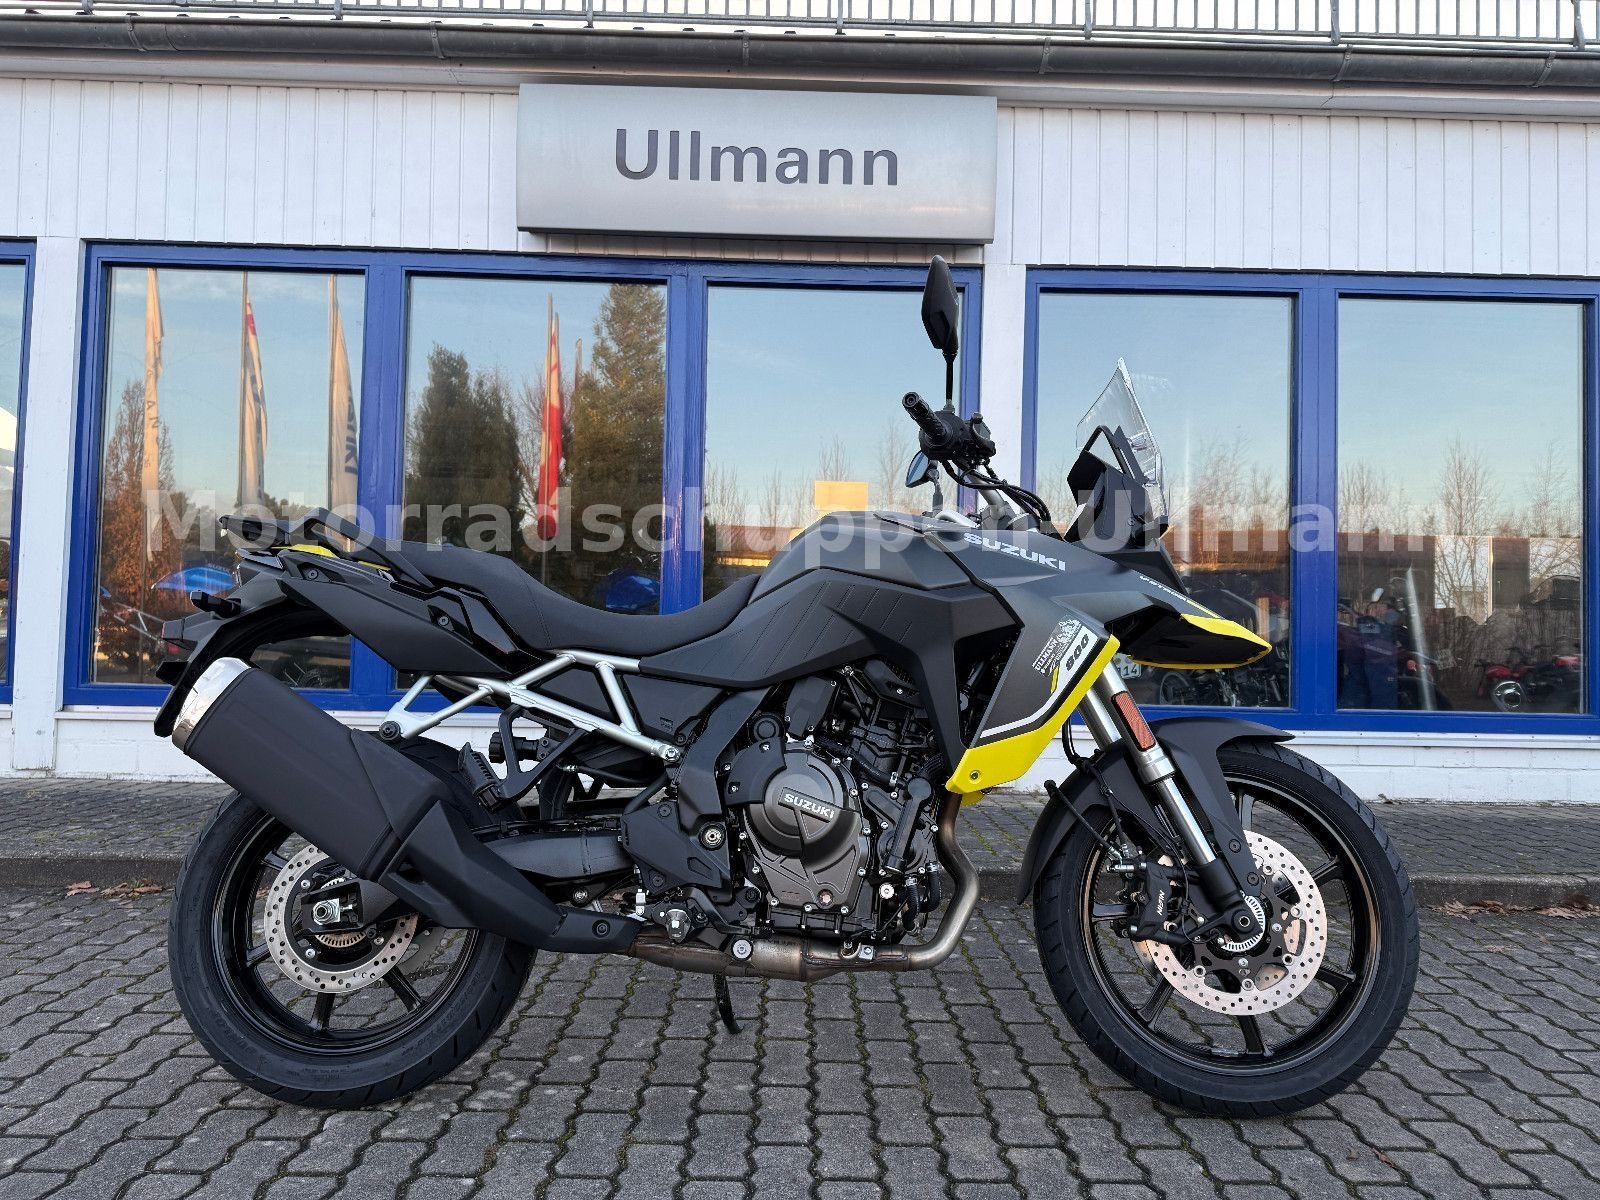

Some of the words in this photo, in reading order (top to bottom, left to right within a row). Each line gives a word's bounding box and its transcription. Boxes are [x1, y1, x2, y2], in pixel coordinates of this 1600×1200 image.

[615, 128, 898, 186] Ullmann
[963, 532, 1066, 571] SUZUKI
[1065, 633, 1091, 672] 800
[783, 793, 835, 819] SUZUKI
